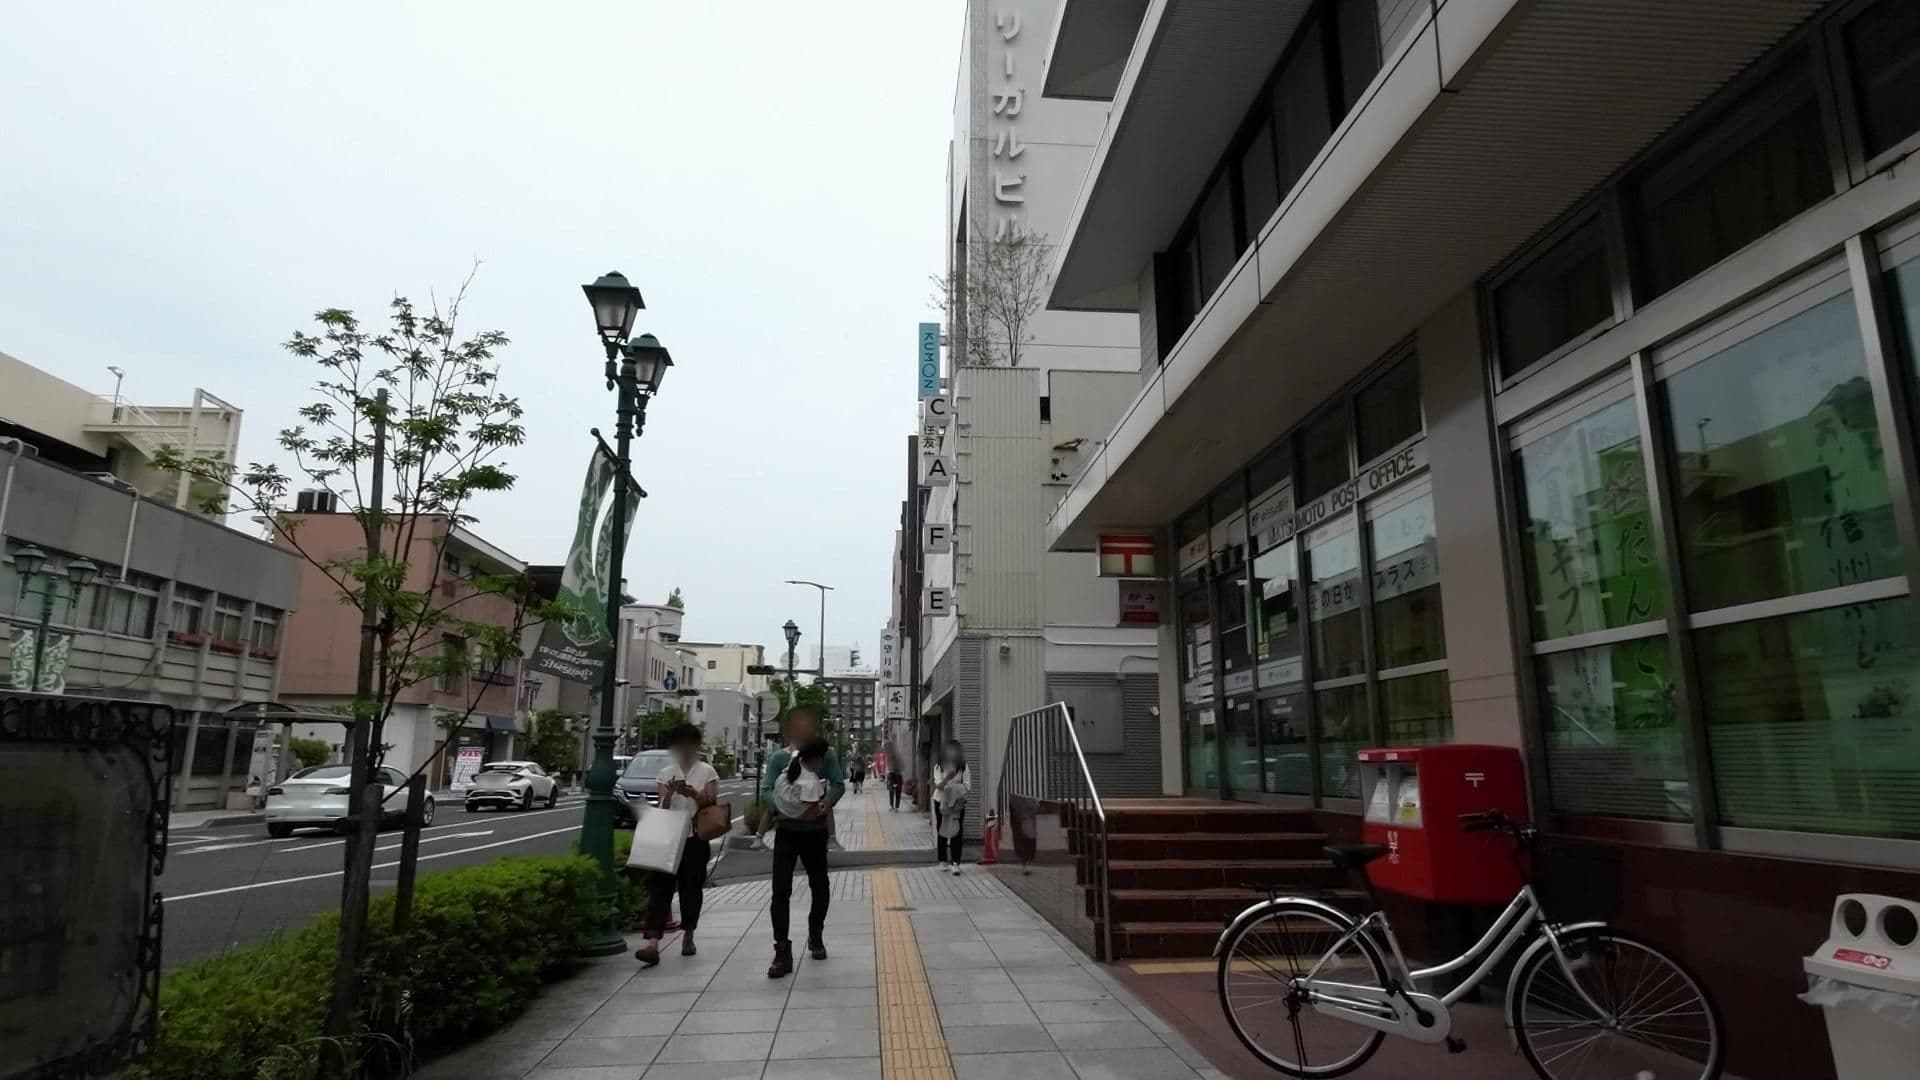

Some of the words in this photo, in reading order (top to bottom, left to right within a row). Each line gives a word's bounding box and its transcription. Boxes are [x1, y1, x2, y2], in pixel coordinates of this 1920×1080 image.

[922, 331, 938, 389] KUMON
[1332, 478, 1361, 511] POST
[1369, 448, 1417, 491] OFFICE
